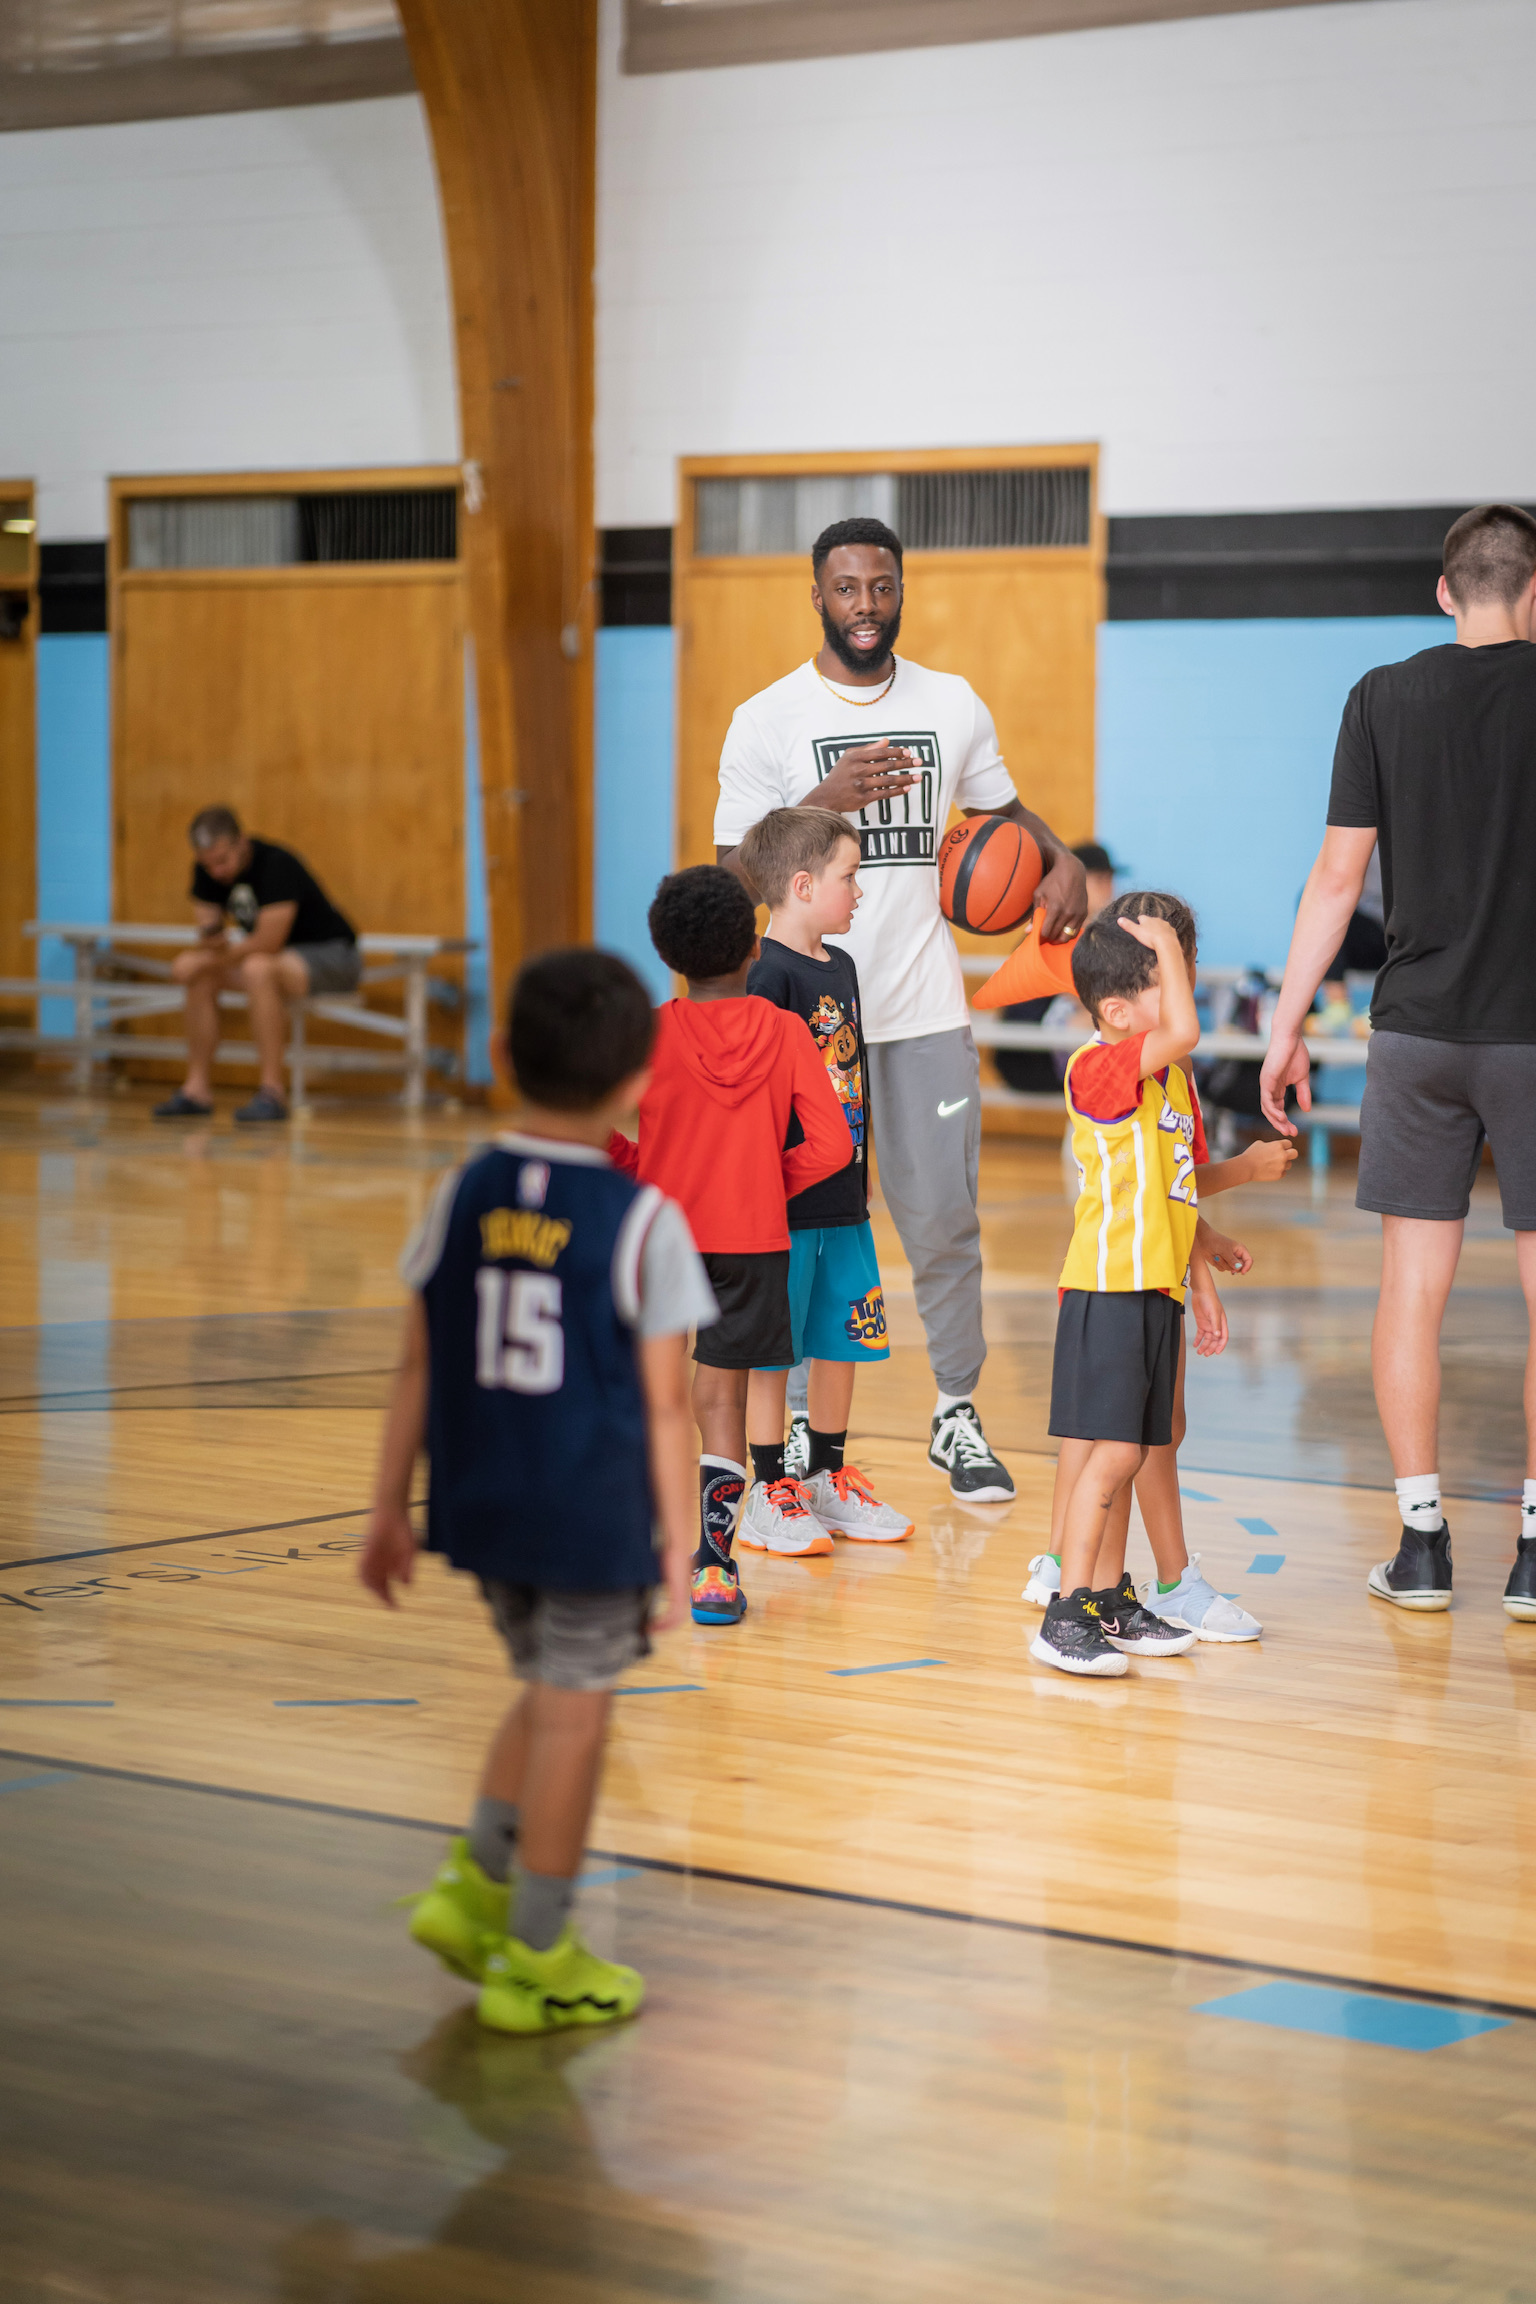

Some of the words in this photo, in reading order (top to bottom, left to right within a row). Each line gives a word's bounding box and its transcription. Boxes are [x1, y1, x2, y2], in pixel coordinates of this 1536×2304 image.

[867, 832, 907, 856] AINT
[919, 832, 931, 855] IT
[1167, 1142, 1198, 1208] 2
[475, 1265, 564, 1395] 15
